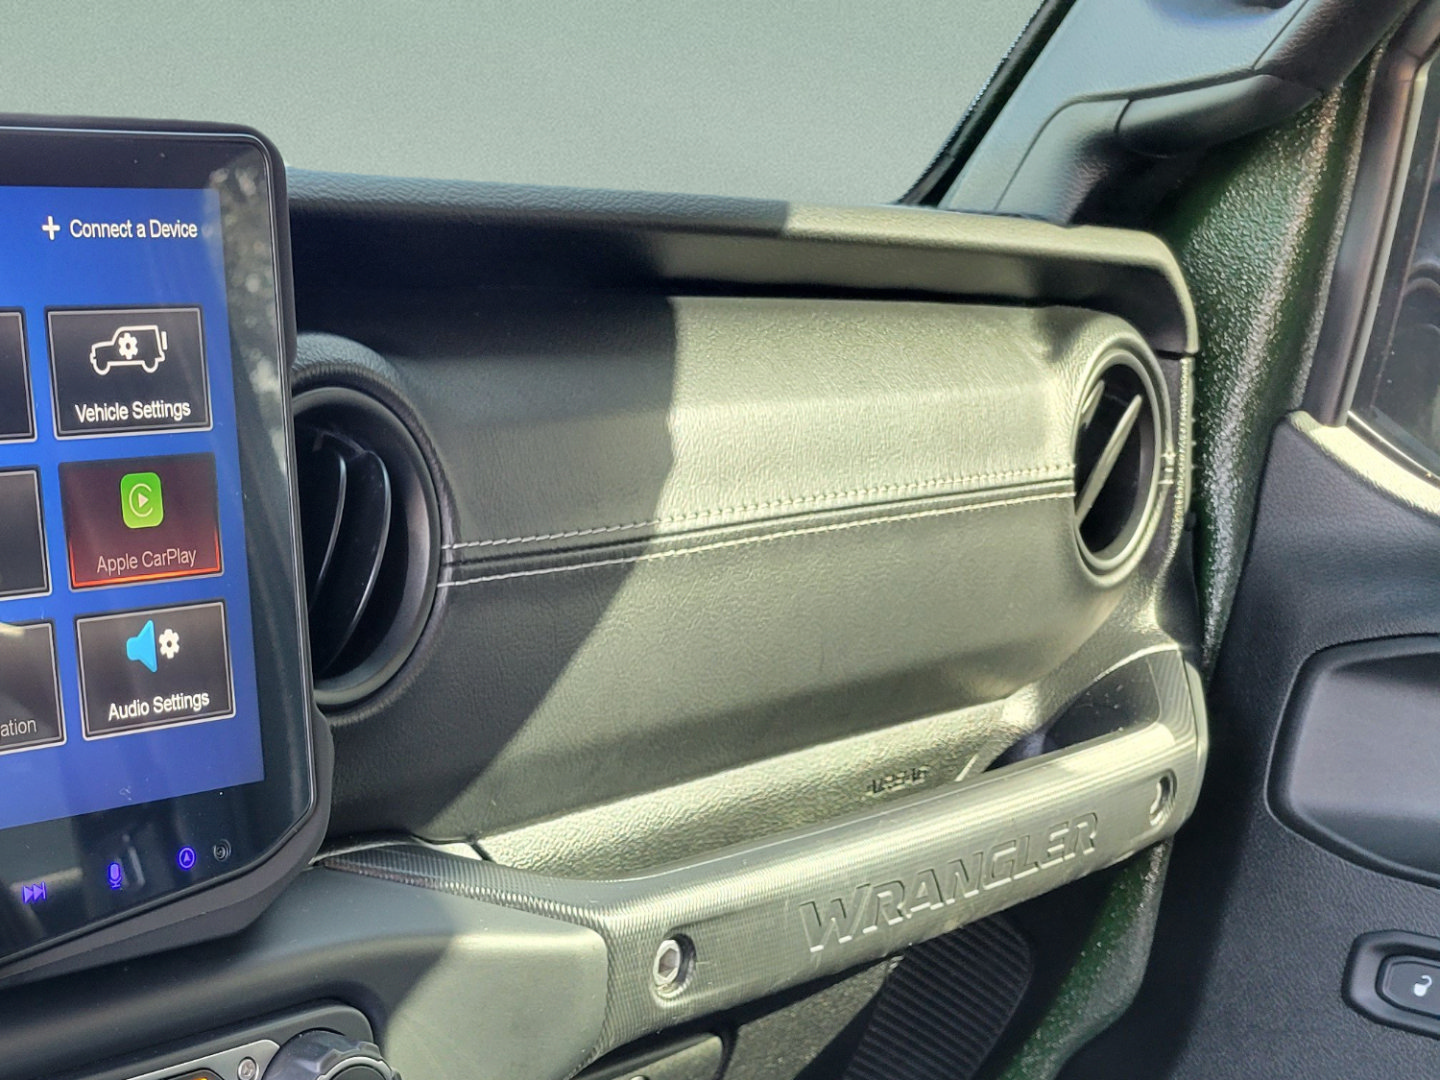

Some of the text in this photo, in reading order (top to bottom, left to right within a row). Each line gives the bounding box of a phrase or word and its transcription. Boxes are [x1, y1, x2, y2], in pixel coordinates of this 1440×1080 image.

[70, 219, 197, 239] Connect a Device
[75, 400, 191, 423] Vehicle Settings
[96, 547, 197, 575] Apple CarPlay
[108, 691, 210, 722] Audio Settings
[799, 812, 1099, 953] WRANGLER
